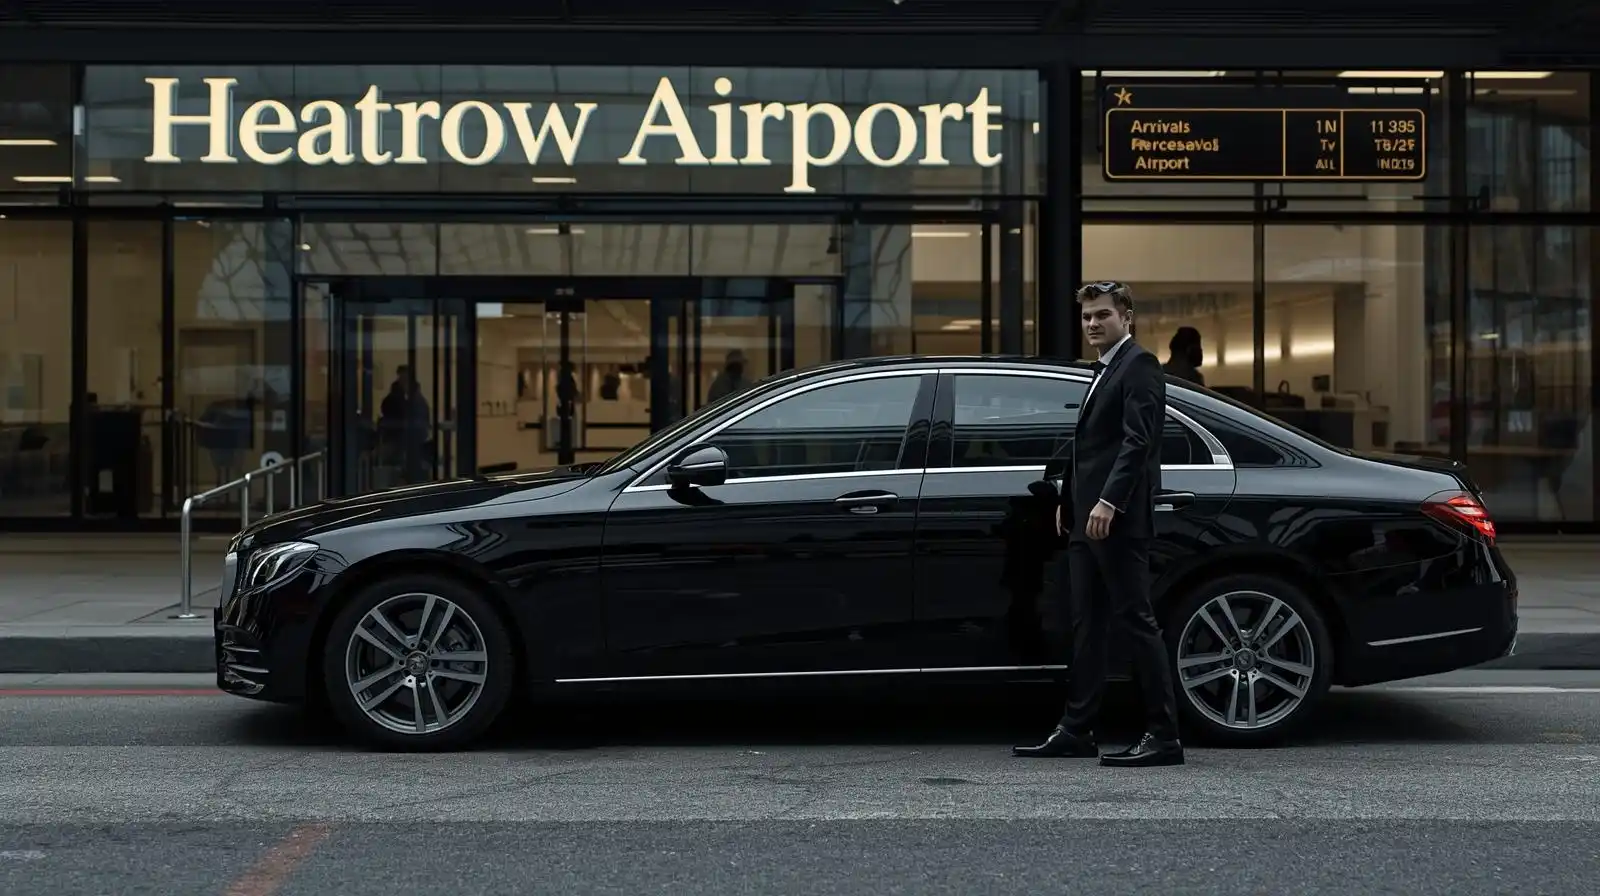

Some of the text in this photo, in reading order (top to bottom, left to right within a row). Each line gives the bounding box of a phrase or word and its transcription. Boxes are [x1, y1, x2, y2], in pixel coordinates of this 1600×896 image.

[145, 76, 1004, 193] Heatrow Airport
[1130, 119, 1191, 134] Arrivals
[1135, 156, 1191, 172] Airport
